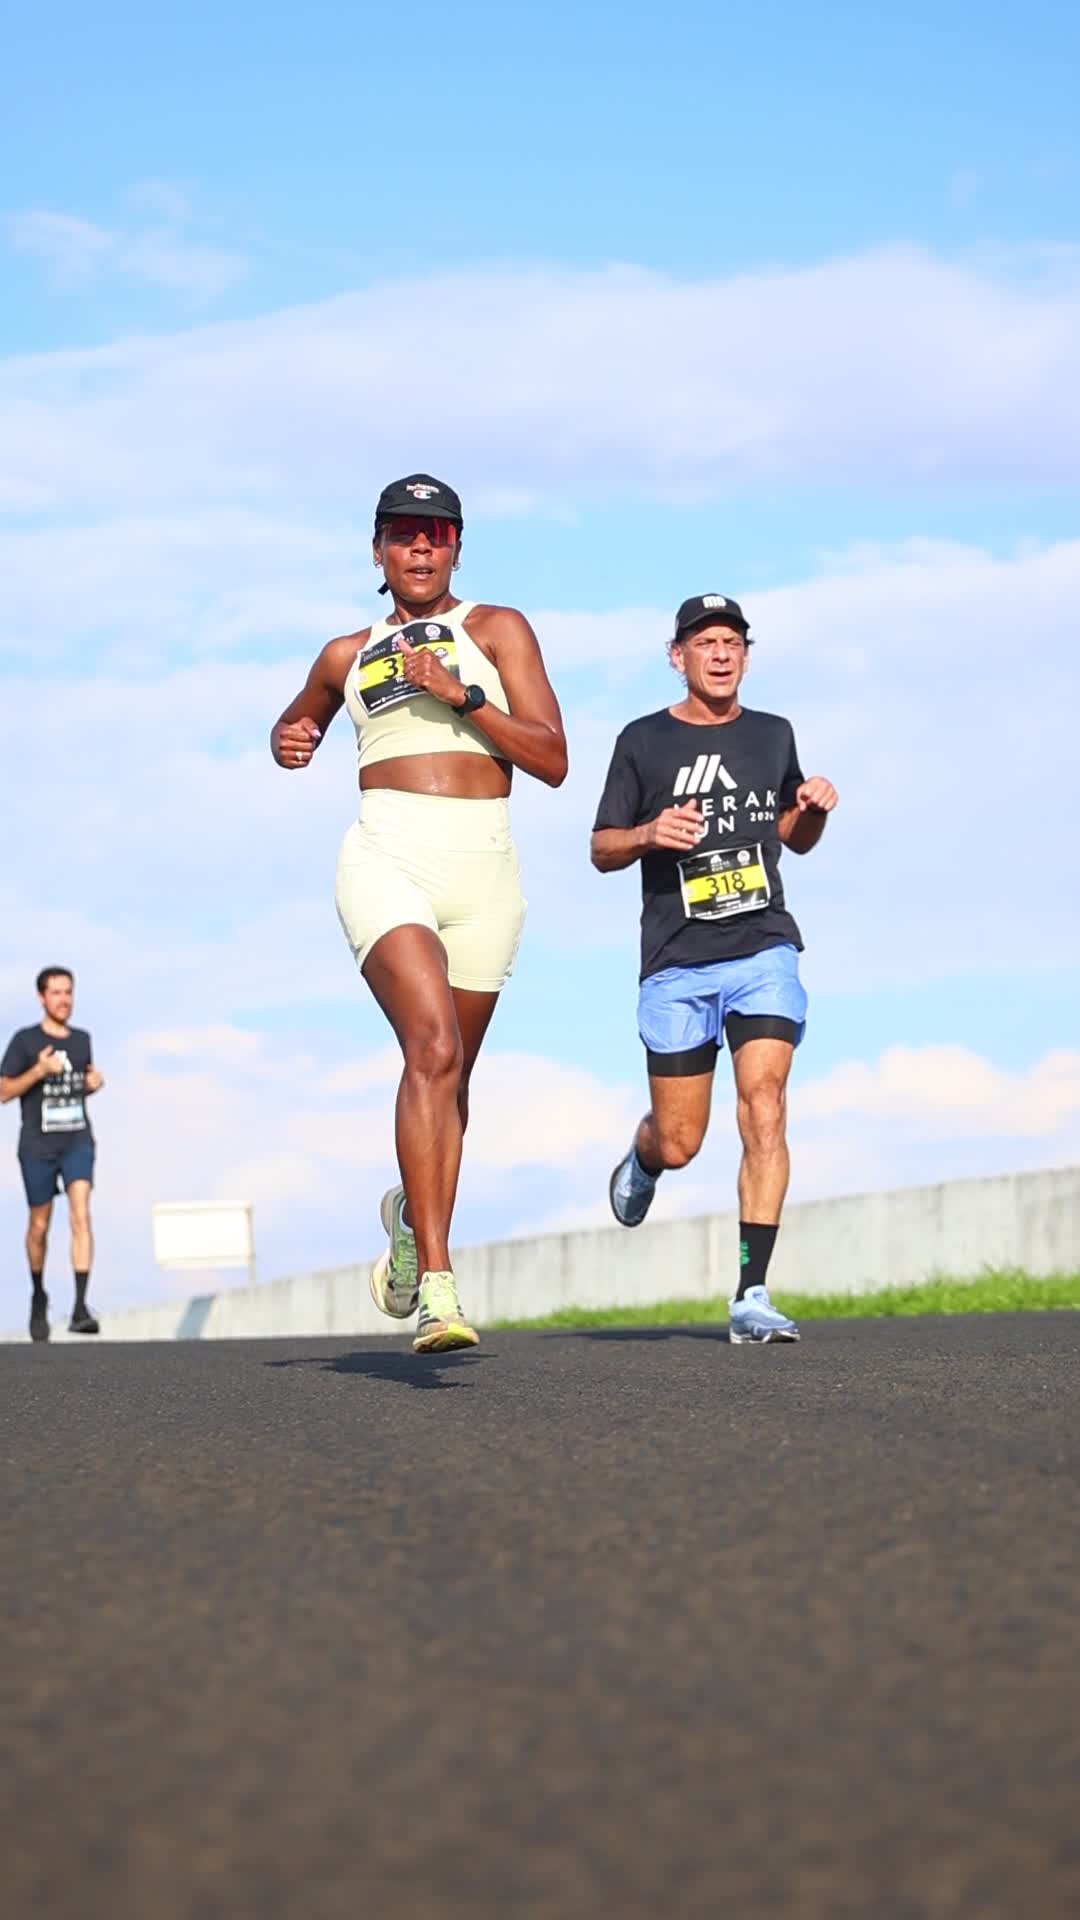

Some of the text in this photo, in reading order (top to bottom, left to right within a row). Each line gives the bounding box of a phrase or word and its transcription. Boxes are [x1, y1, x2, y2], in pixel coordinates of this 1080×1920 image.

[674, 790, 776, 816] ERAK
[695, 815, 735, 839] UN
[705, 871, 746, 897] 318
